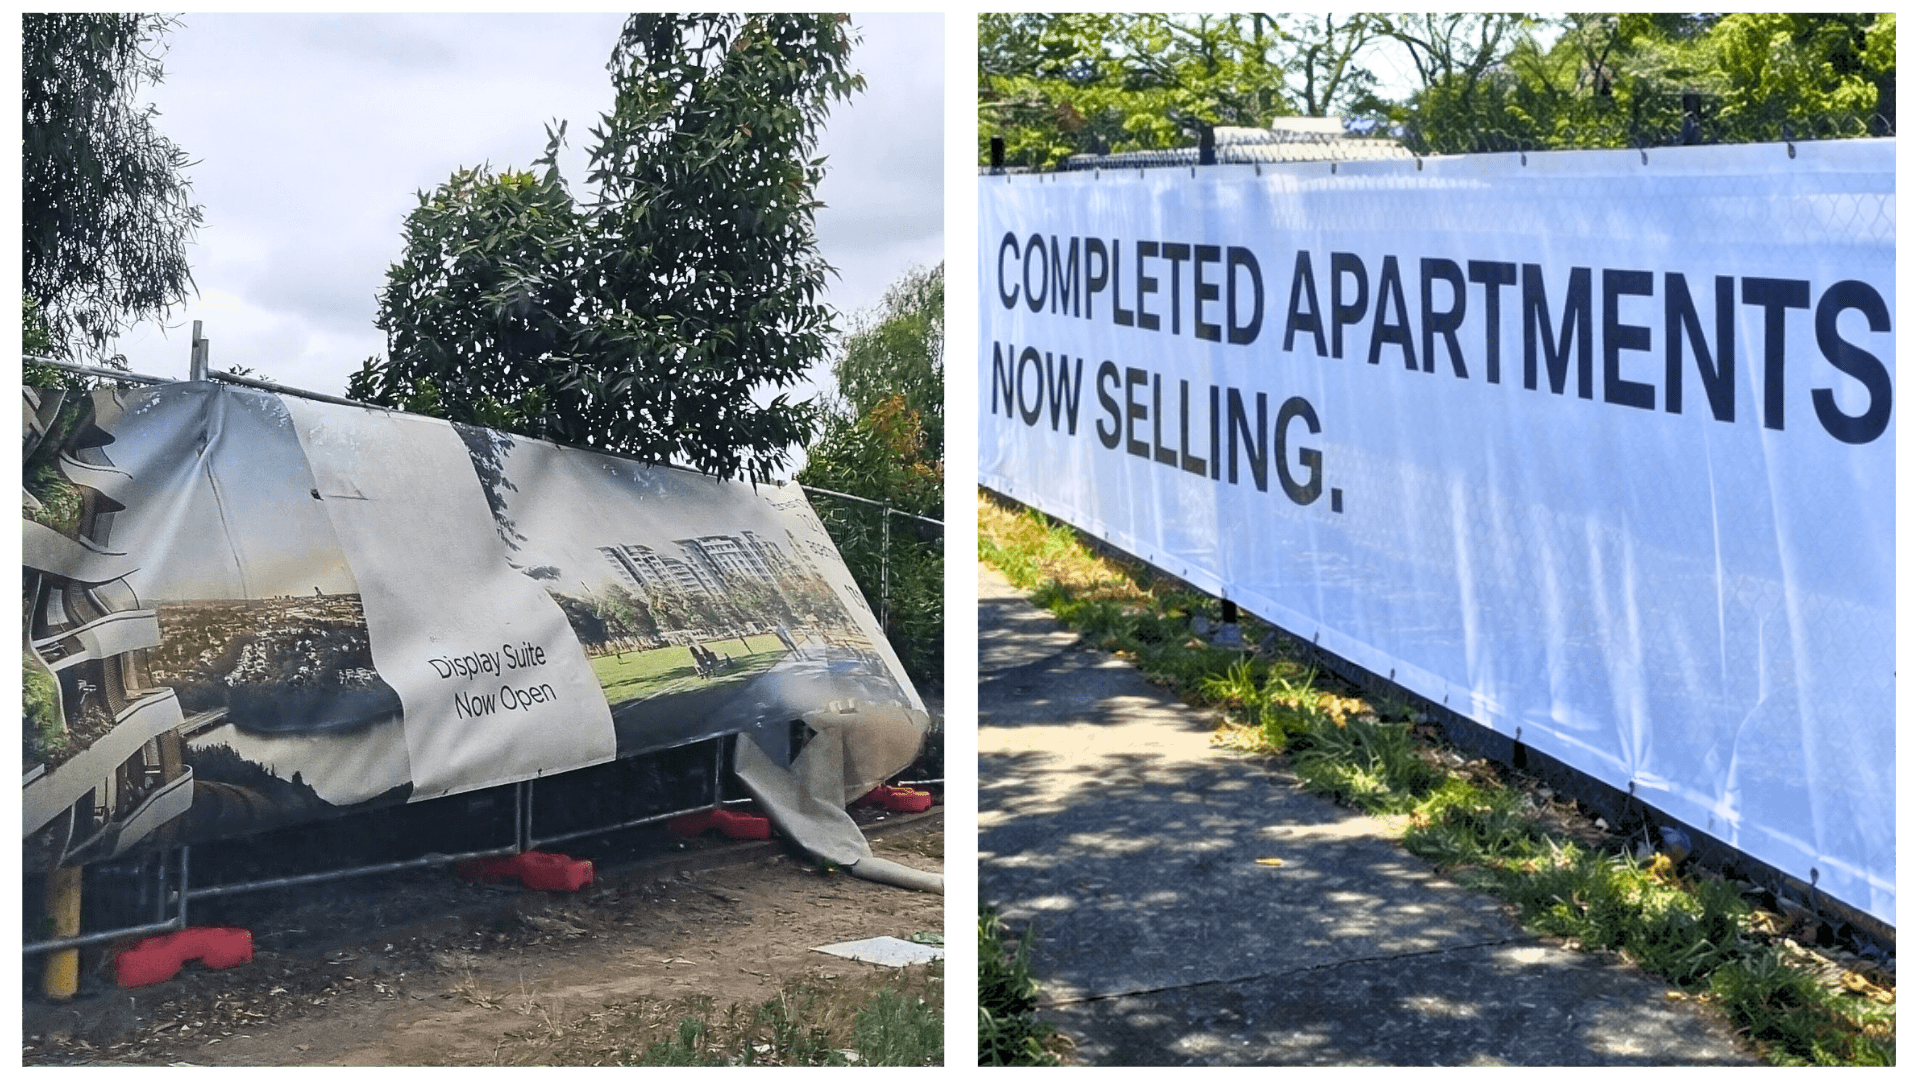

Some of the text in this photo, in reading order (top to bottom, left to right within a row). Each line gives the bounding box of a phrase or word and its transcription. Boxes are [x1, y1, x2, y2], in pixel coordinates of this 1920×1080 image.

[999, 231, 1893, 445] COMPLETED APARTMENTS
[991, 340, 1344, 514] NOW SELLING.
[428, 641, 547, 680] Display Suite
[454, 683, 557, 719] Now Open
